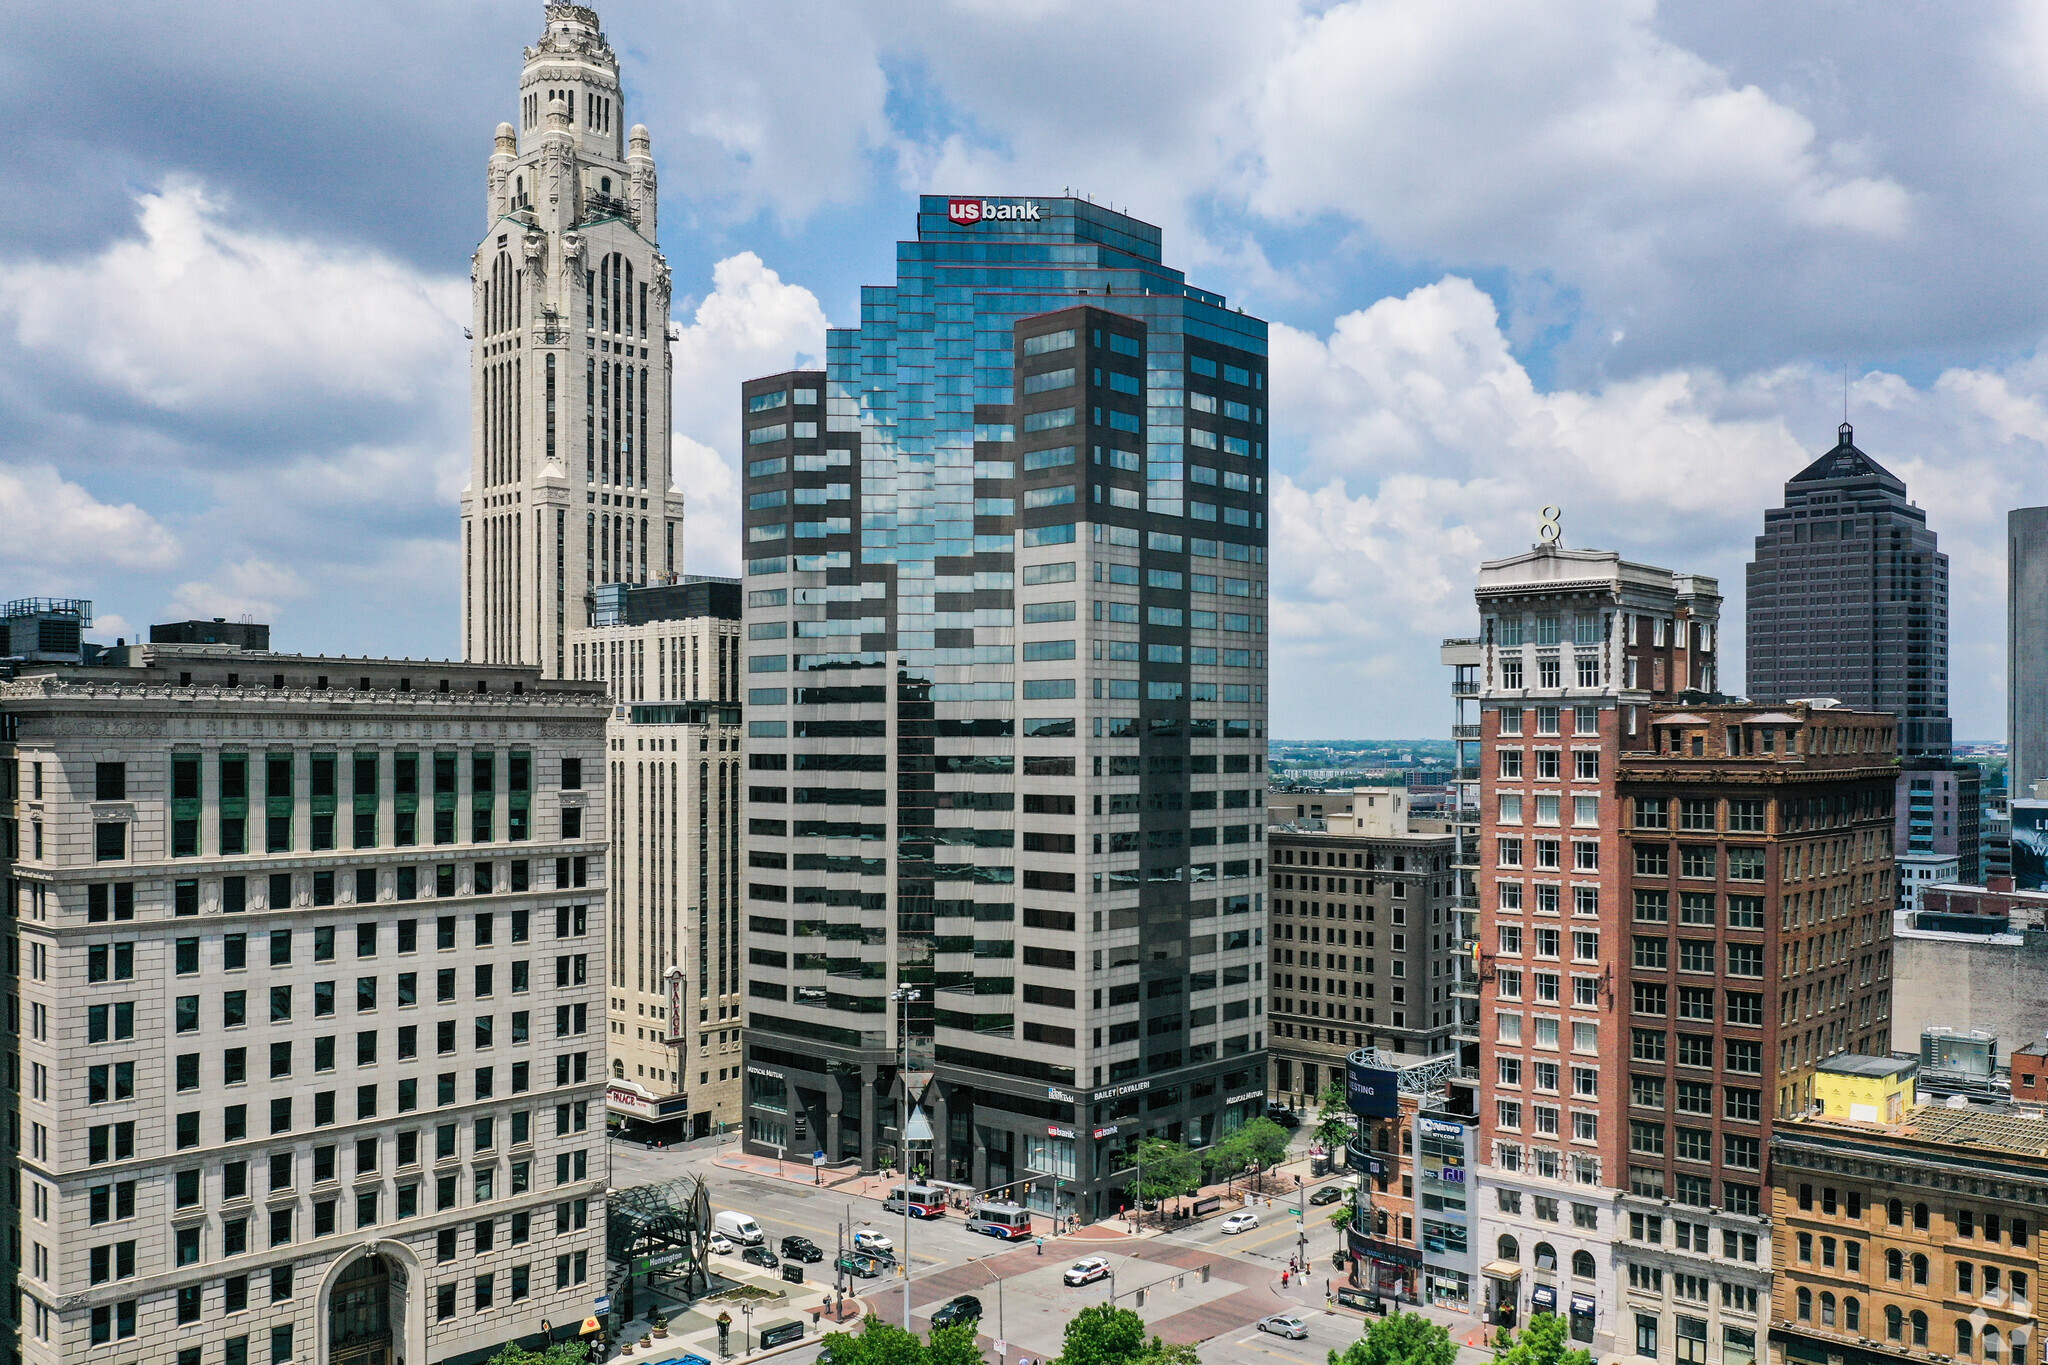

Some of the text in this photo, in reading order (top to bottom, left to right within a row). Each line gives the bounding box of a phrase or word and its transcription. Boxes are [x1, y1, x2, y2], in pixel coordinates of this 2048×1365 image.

[1538, 504, 1561, 543] 8
[672, 982, 680, 1036] PALACE
[613, 1092, 636, 1106] PALACE
[1094, 1081, 1150, 1101] BAILEY CAVALIERI
[650, 1253, 682, 1266] Huntington
